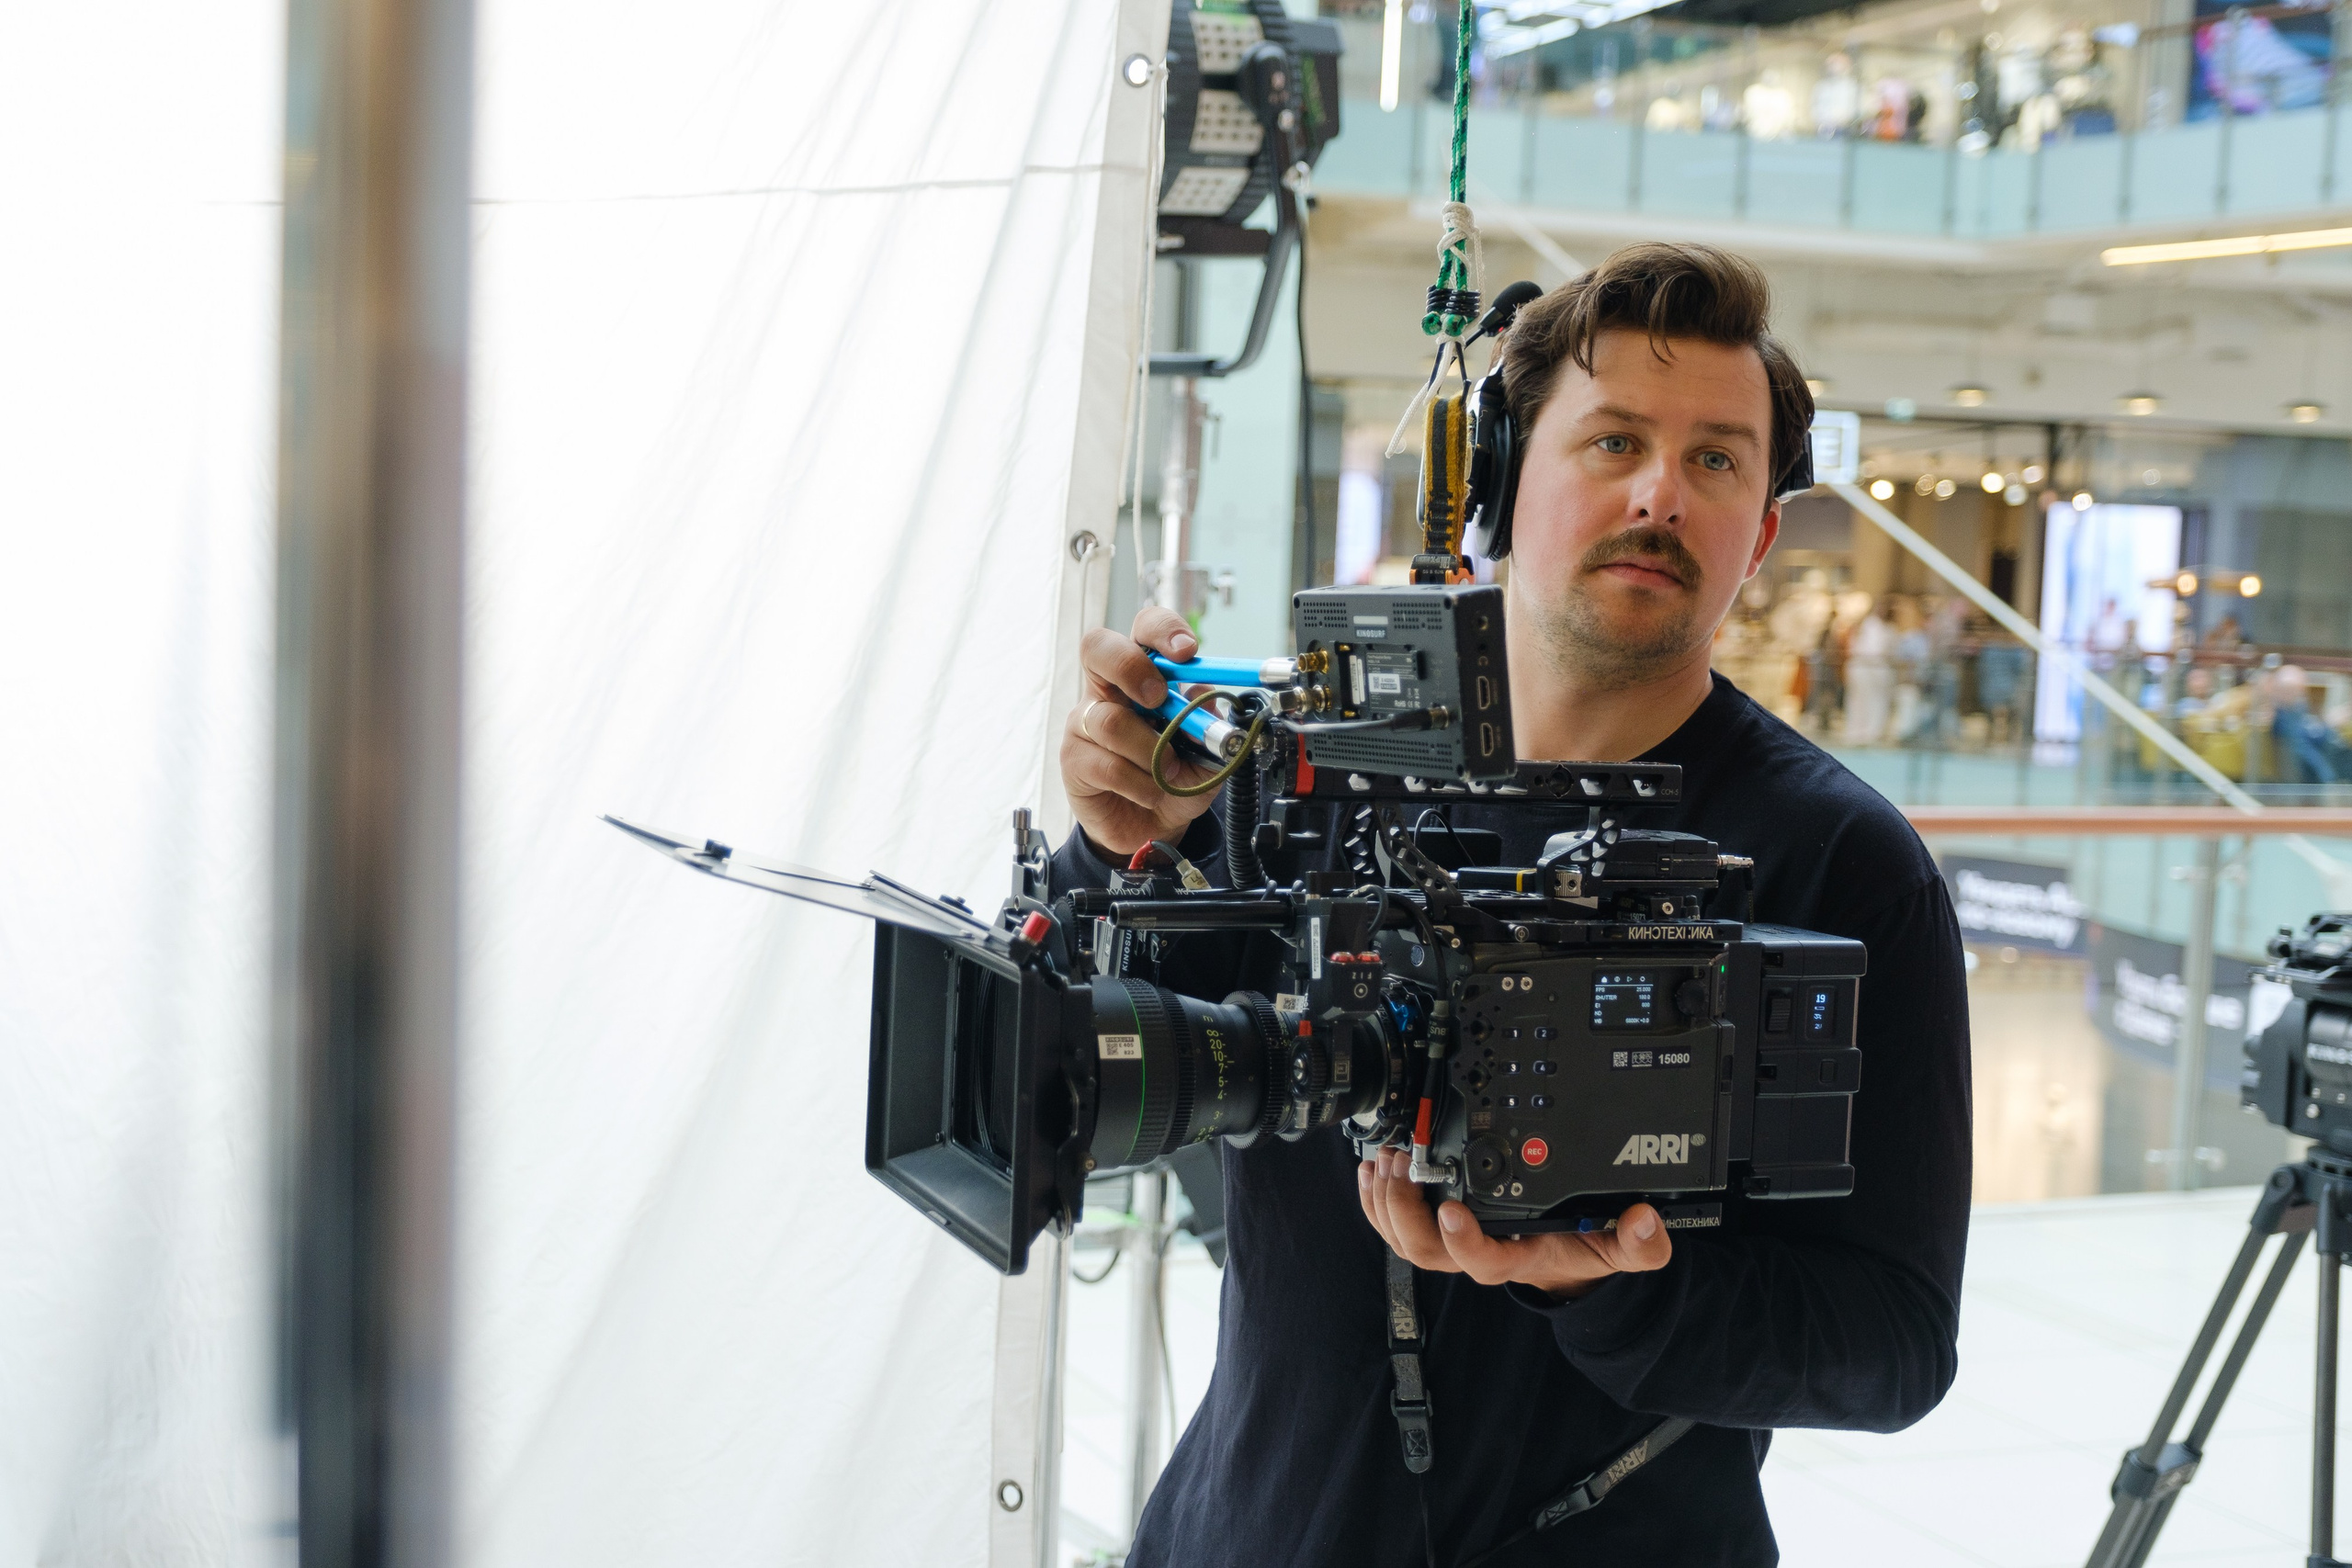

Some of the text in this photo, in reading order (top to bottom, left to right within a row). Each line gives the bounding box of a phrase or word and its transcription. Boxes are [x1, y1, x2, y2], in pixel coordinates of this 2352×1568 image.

[1355, 629, 1385, 638] KINOSURF
[1122, 930, 1133, 972] KINOSU
[1815, 994, 1826, 1003] 19
[1512, 1030, 1547, 1038] 1 2
[1209, 1039, 1222, 1049] 20
[1213, 1051, 1224, 1062] 10
[1657, 1053, 1690, 1065] 15080
[1218, 1063, 1225, 1074] 7
[1510, 1064, 1545, 1072] 3 4
[1218, 1077, 1225, 1088] 5
[1217, 1090, 1223, 1100] 4
[1510, 1098, 1544, 1106] 5 6
[1214, 1111, 1220, 1120] 3
[1612, 1134, 1690, 1165] ARRI
[1604, 1219, 1618, 1229] AR
[1662, 1217, 1720, 1229] ИНОТЕХНИКА
[1607, 1439, 1648, 1484] ARRI
